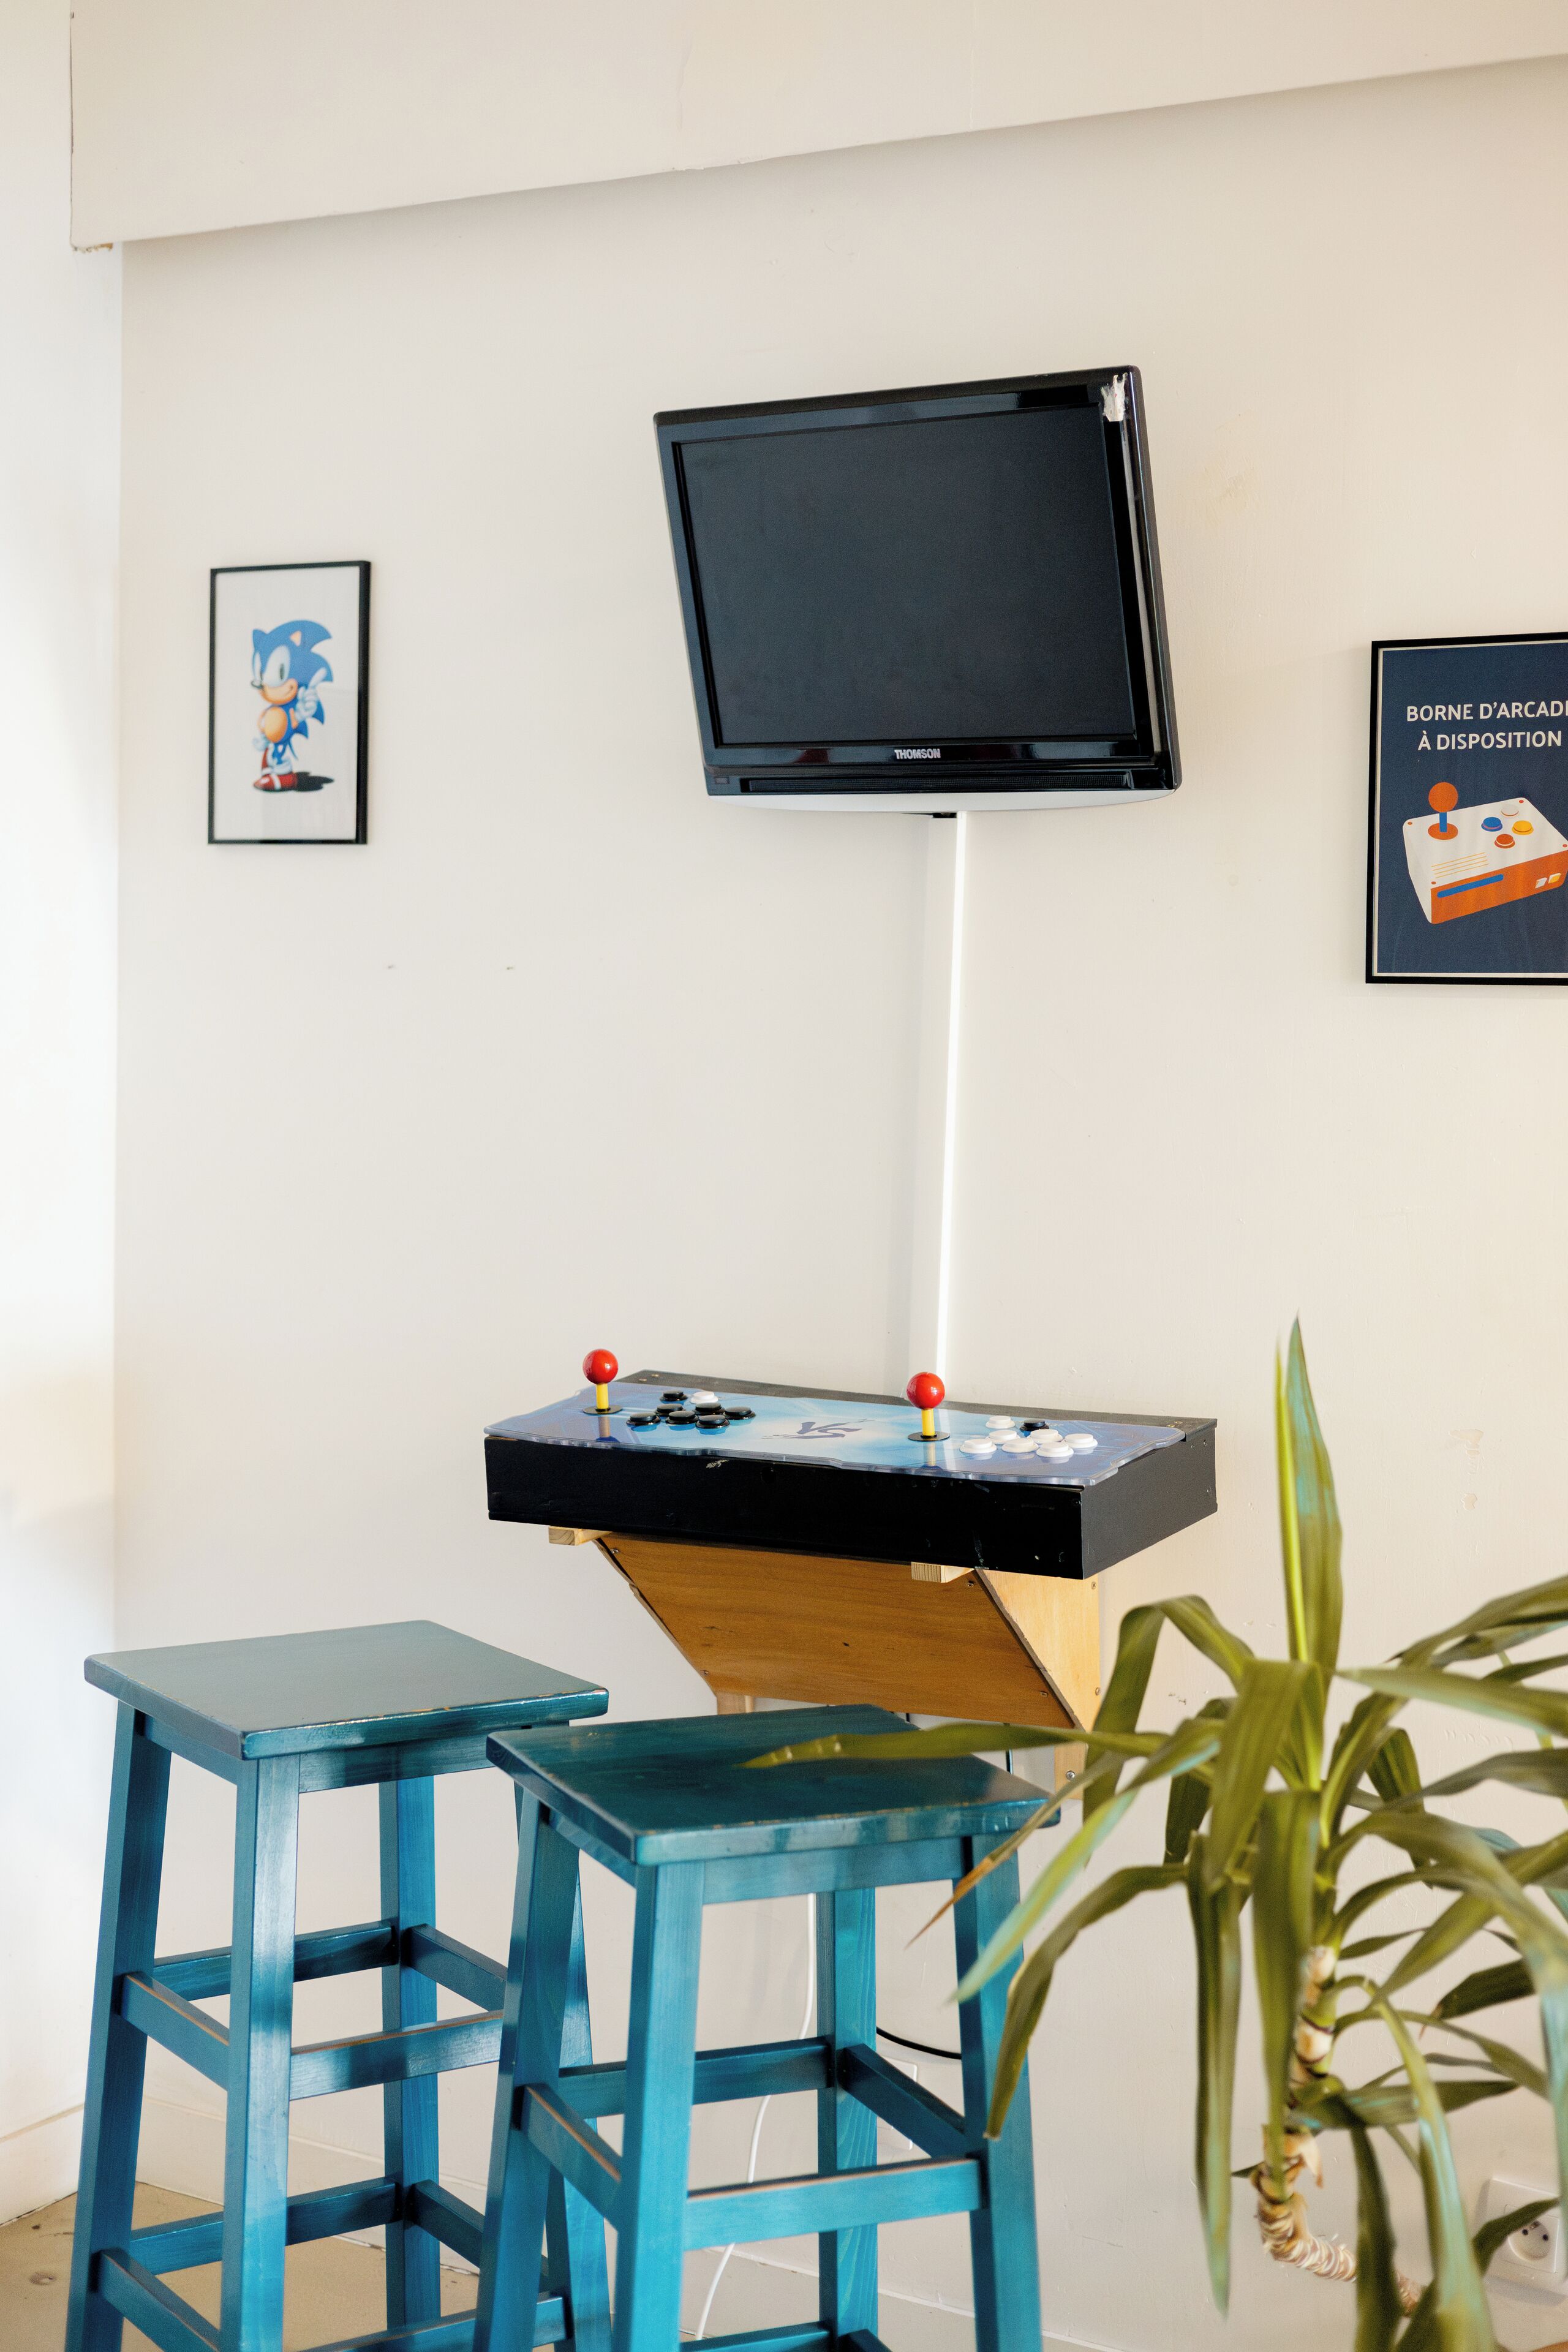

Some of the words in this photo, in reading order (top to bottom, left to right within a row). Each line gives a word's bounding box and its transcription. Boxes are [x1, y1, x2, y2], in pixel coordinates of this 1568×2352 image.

[1407, 704, 1474, 722] BORNE
[1479, 700, 1568, 719] D’ARCAD
[1417, 730, 1431, 751] À
[1436, 730, 1562, 750] DISPOSITION
[894, 748, 941, 760] THOMSON
